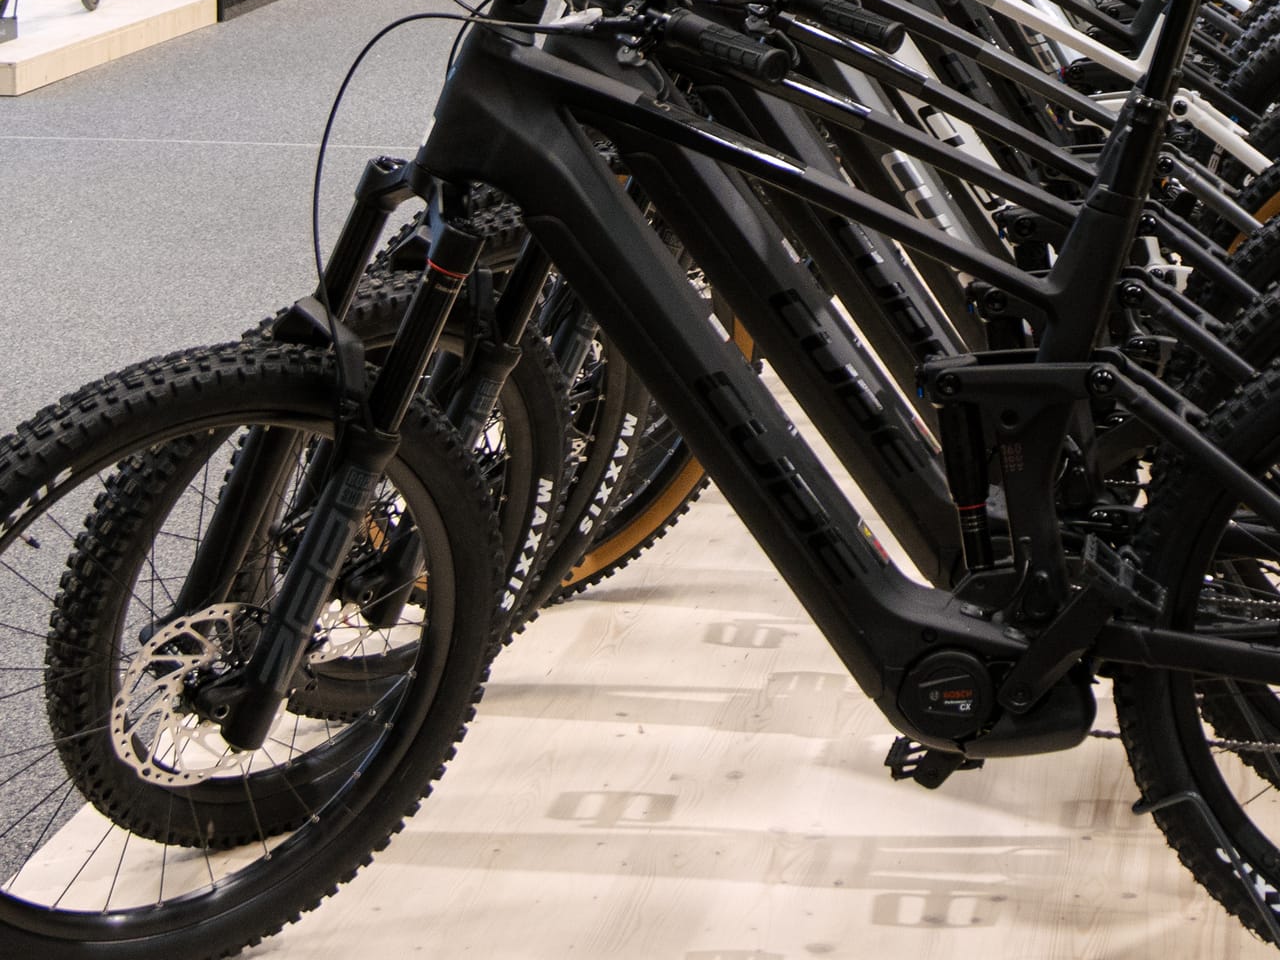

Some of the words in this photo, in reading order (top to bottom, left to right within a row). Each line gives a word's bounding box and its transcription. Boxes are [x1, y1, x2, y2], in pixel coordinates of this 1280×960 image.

[769, 288, 925, 478] CUBE
[579, 412, 638, 535] MAXXIS
[695, 370, 869, 585] CUBE
[501, 477, 554, 611] MAXXIS
[959, 703, 972, 711] CX
